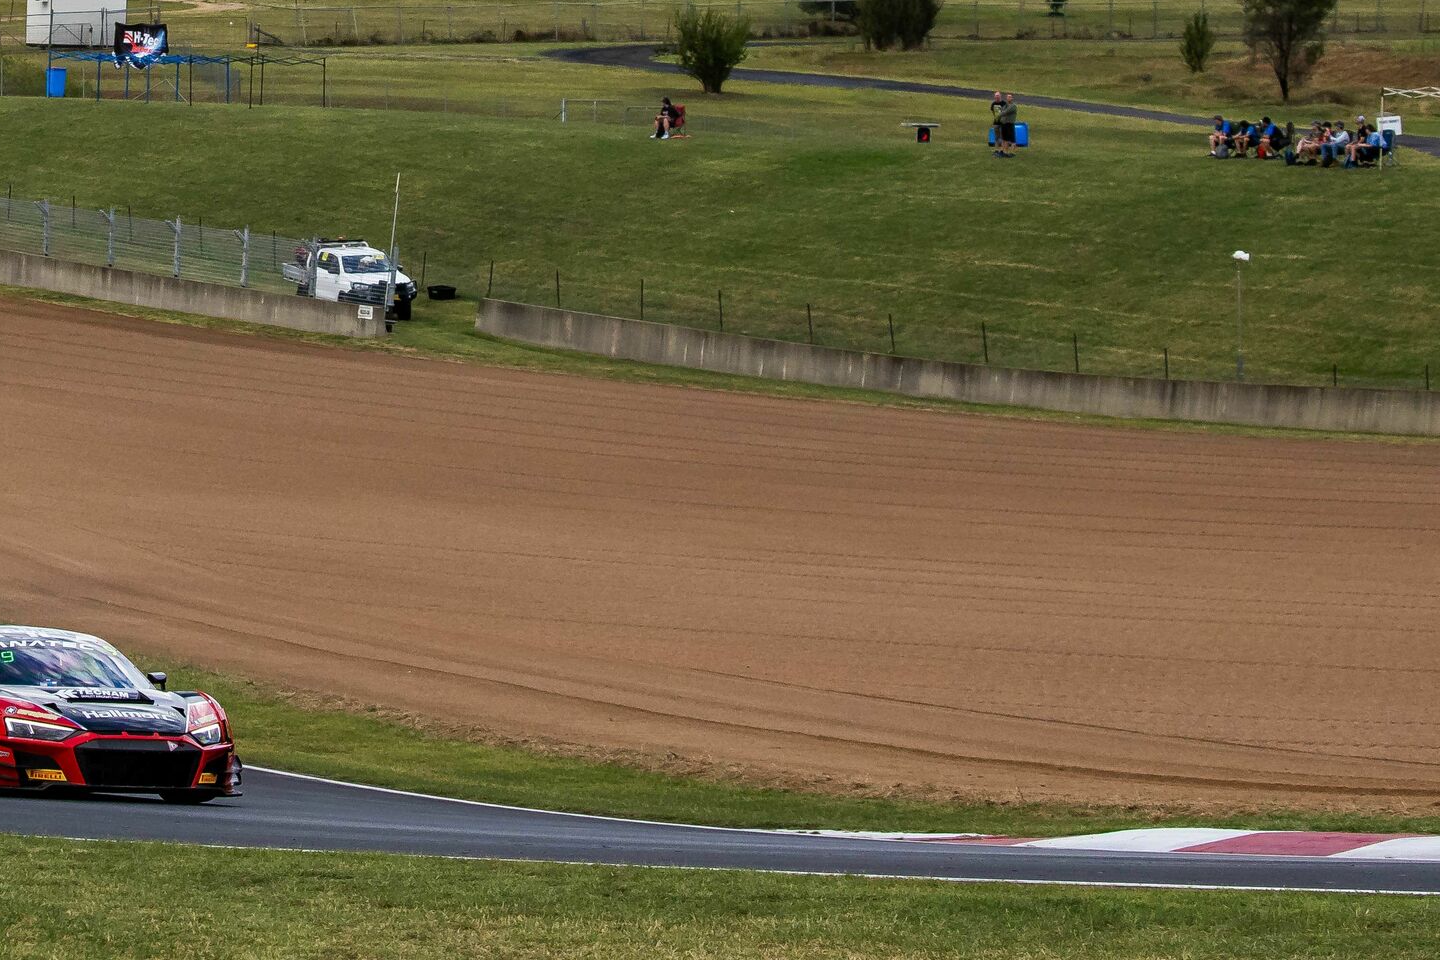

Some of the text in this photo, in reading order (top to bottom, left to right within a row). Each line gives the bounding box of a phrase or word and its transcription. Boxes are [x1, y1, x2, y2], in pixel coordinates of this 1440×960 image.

[76, 689, 129, 699] TECNAM
[82, 709, 173, 721] Hallmarc
[30, 770, 64, 780] PIRELLI
